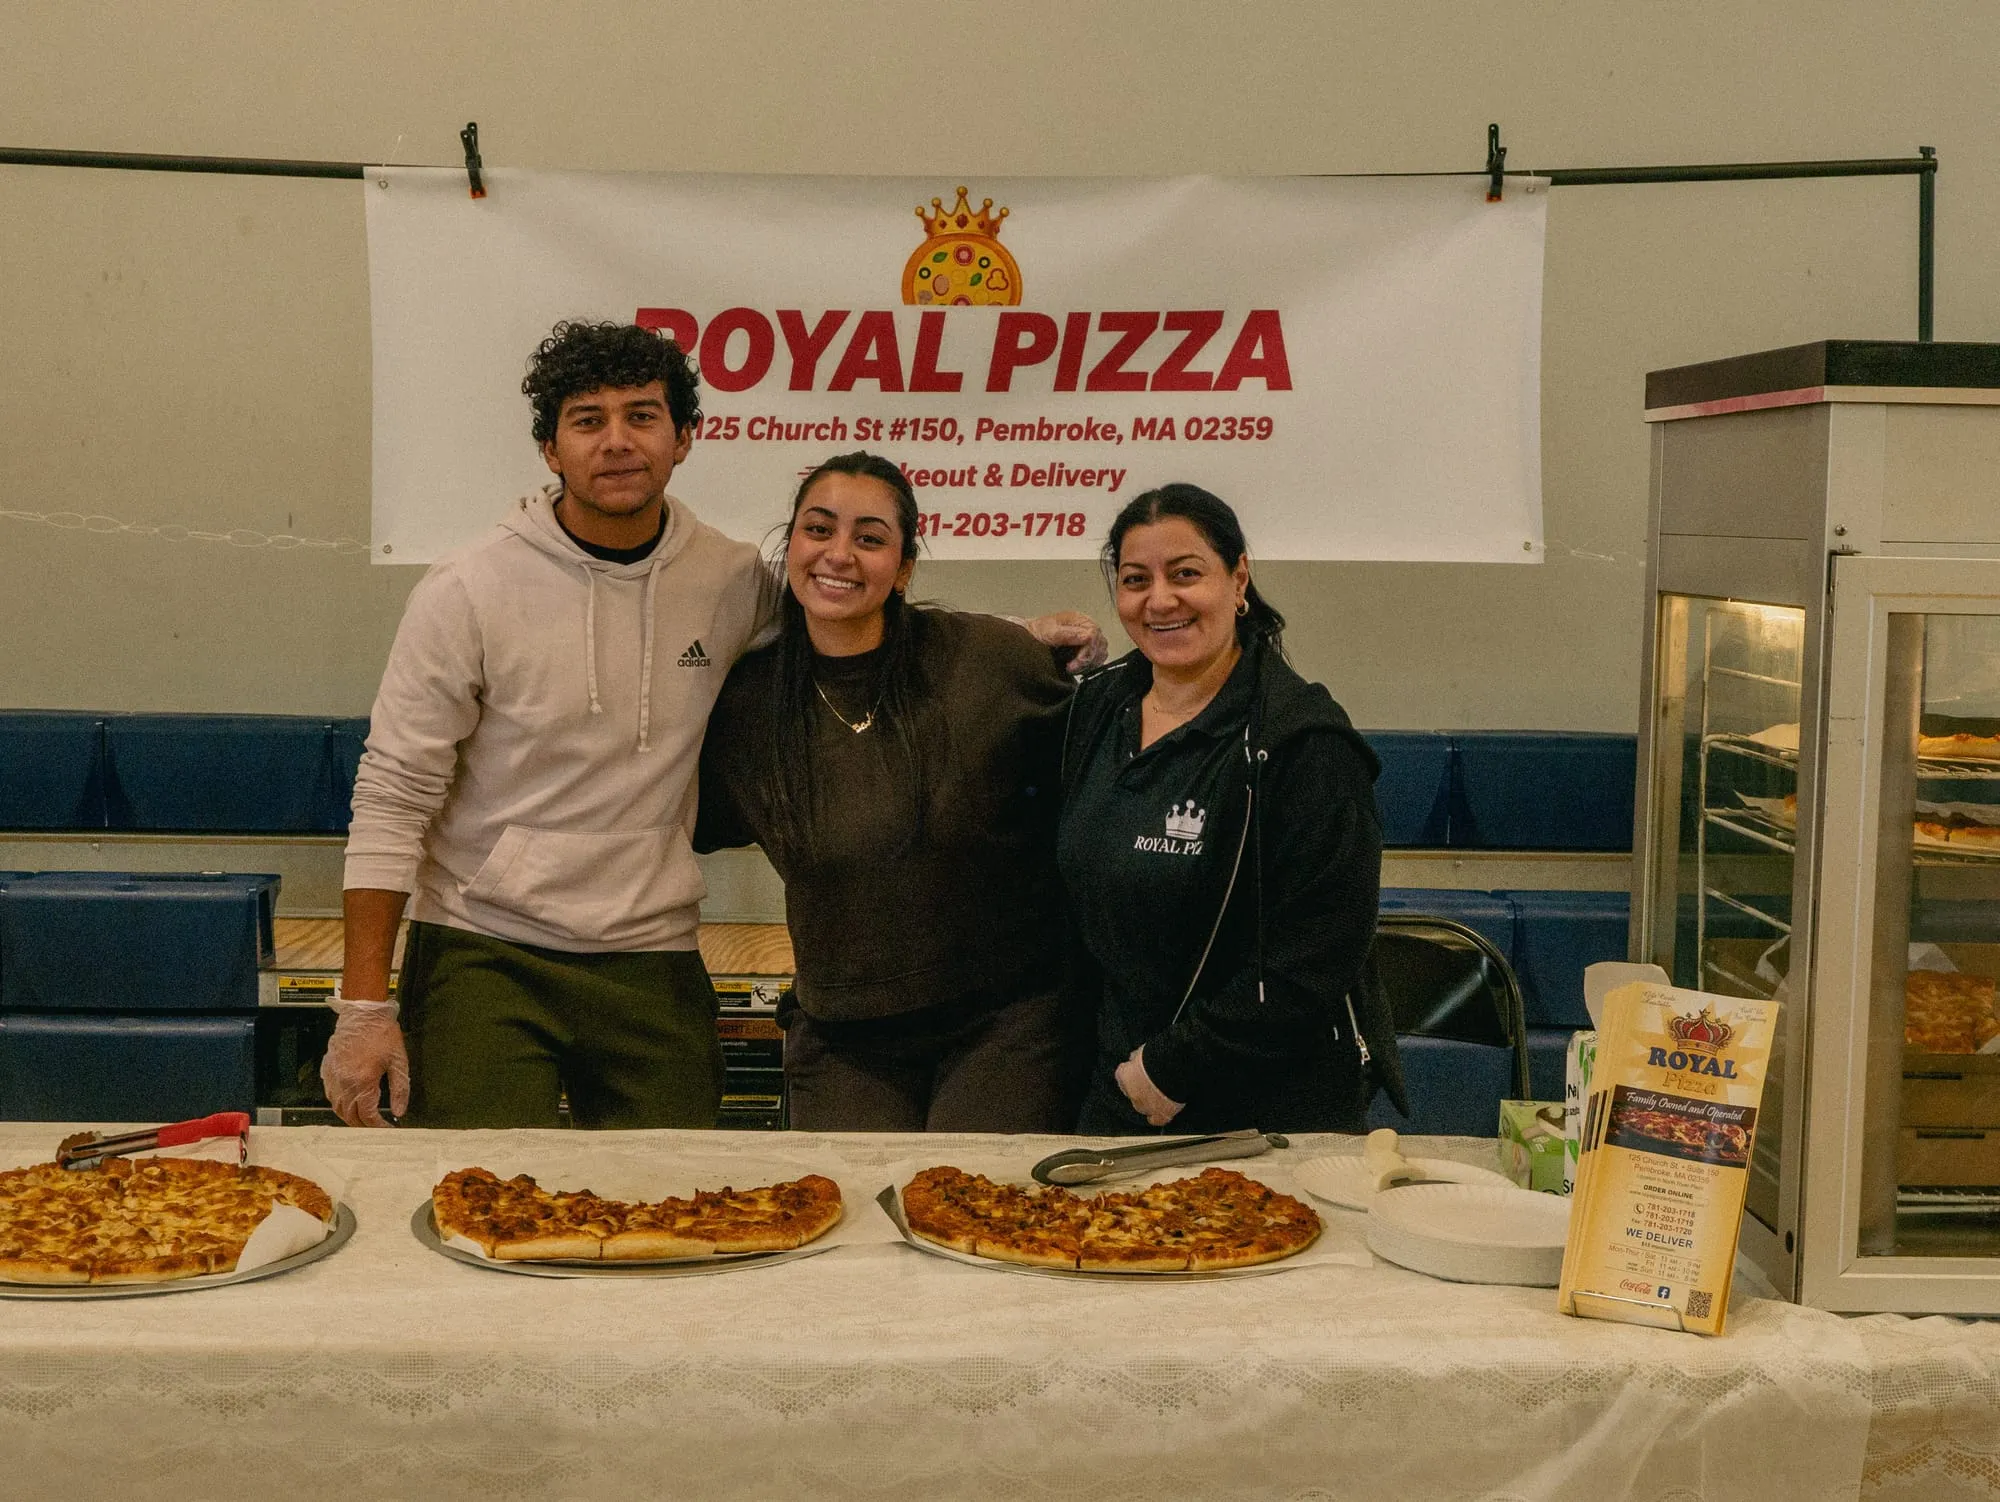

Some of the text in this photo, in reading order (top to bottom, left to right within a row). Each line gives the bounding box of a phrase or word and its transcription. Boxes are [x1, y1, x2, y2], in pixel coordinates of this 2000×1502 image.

[985, 310, 1293, 392] PIZZA
[695, 416, 1274, 446] 125 Church St #150, Pembroke, MA 02359
[900, 462, 1126, 493] keout & Delivery
[915, 512, 1087, 537] 81-203-1718
[677, 656, 711, 668] adidas
[1134, 835, 1180, 854] ROYAL
[1647, 1046, 1738, 1080] ROYAL
[1662, 1071, 1718, 1096] Pizza
[1626, 1092, 1745, 1121] Family Owned and Operated
[1642, 1156, 1669, 1168] Church
[1643, 1184, 1666, 1194] ORDER
[1667, 1189, 1694, 1200] ONLINE
[1645, 1211, 1694, 1227] 781-203-1719
[1647, 1202, 1696, 1218] 781-203-1718
[1626, 1227, 1644, 1239] WE
[1646, 1231, 1694, 1249] DELIVER
[1643, 1219, 1693, 1236] 781-203-1720
